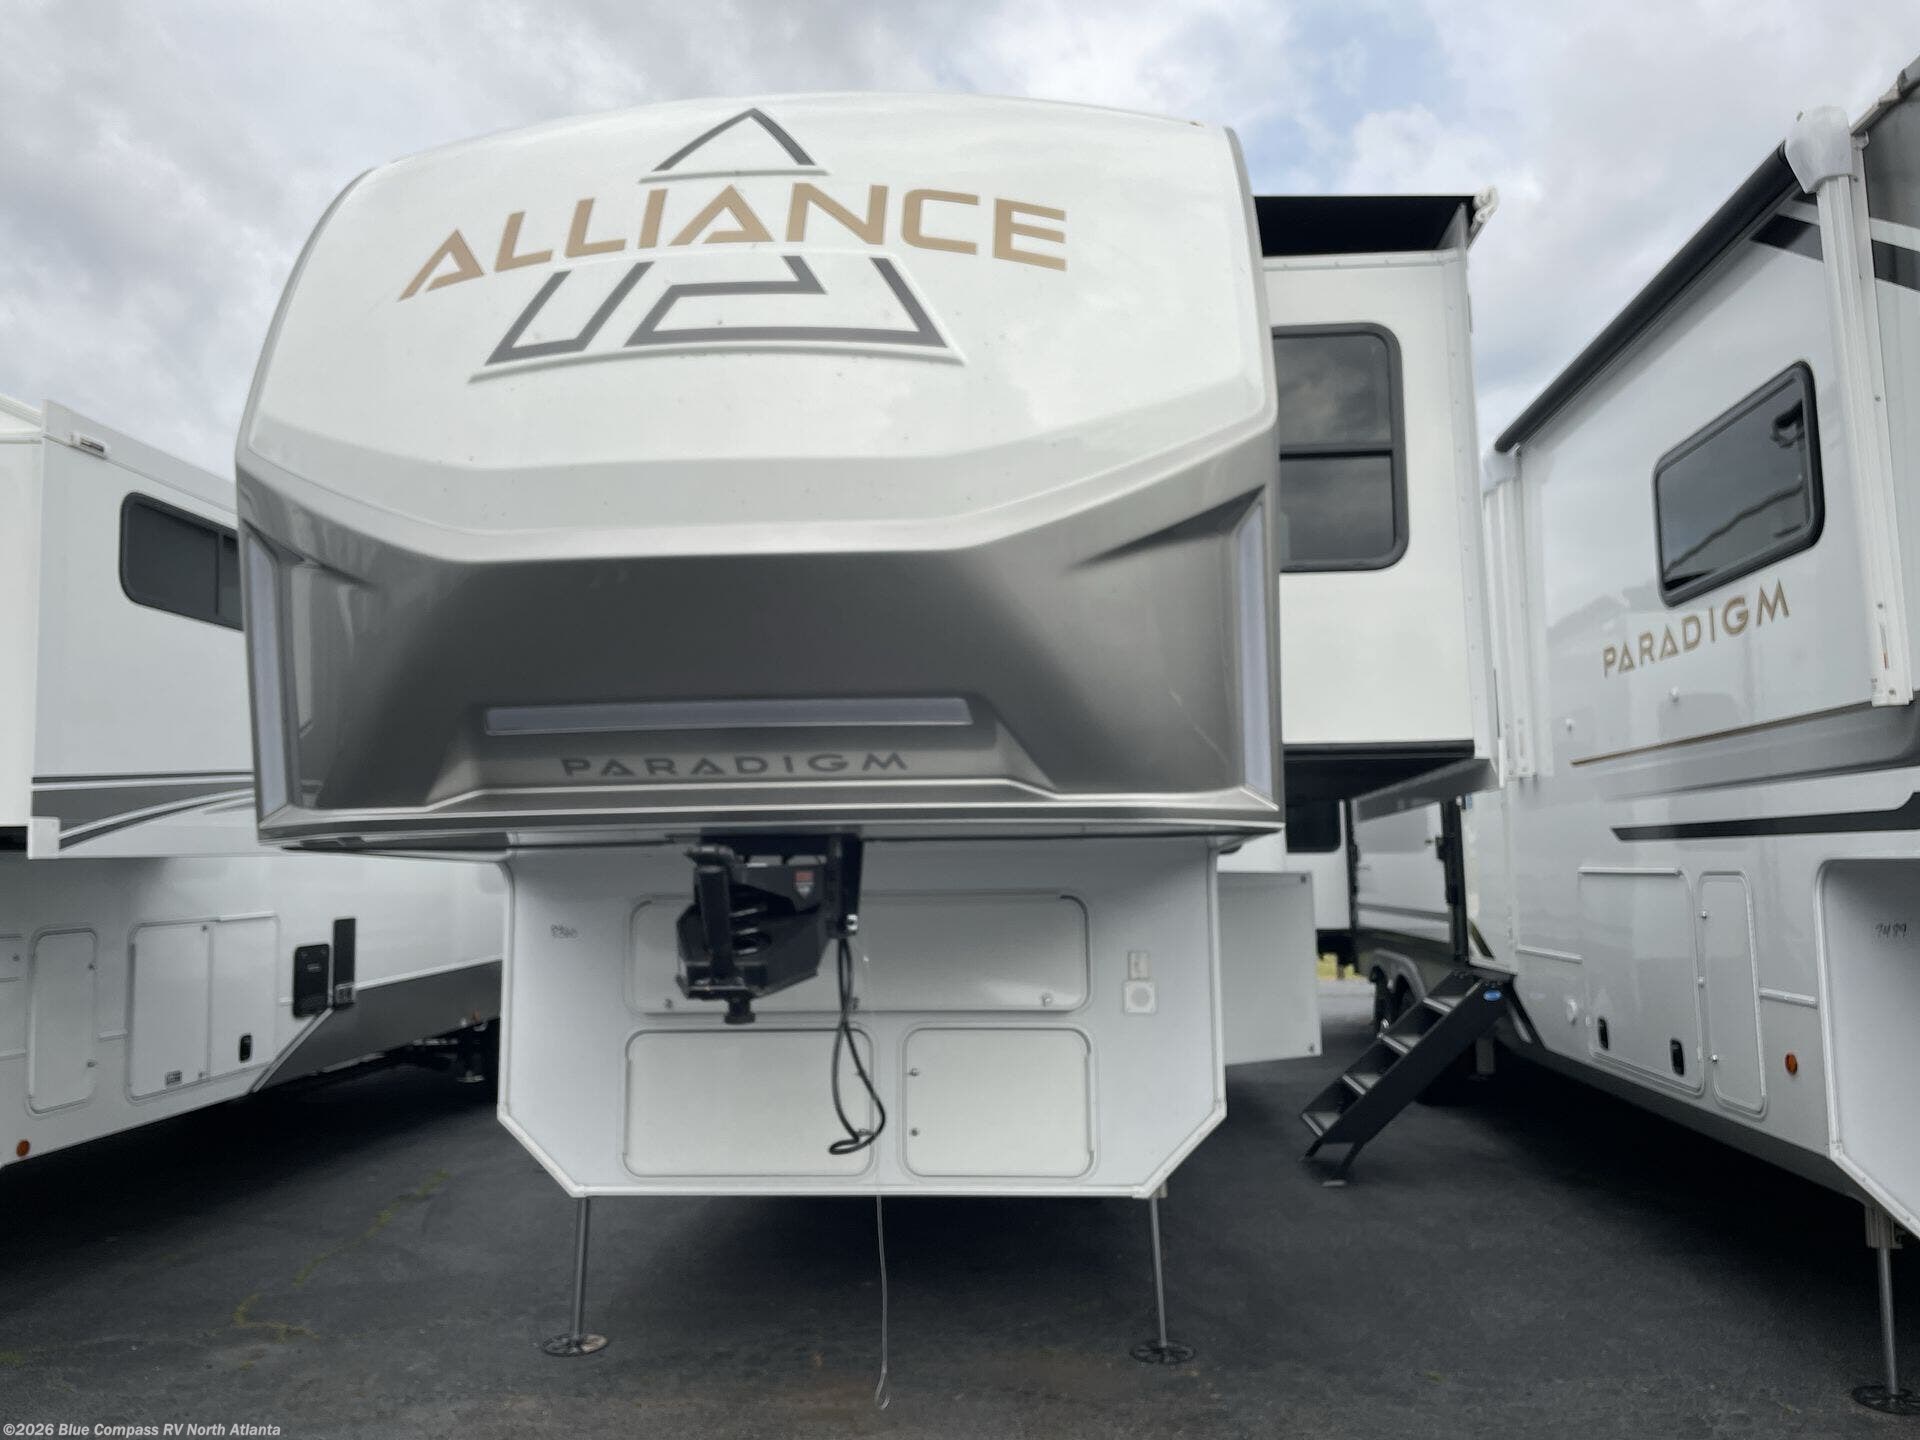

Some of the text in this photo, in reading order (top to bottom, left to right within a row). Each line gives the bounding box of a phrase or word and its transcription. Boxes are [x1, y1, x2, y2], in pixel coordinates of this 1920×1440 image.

[399, 182, 1067, 301] ALLIANCE
[1603, 578, 1790, 678] PARADIGM
[561, 752, 909, 776] PARADIGM
